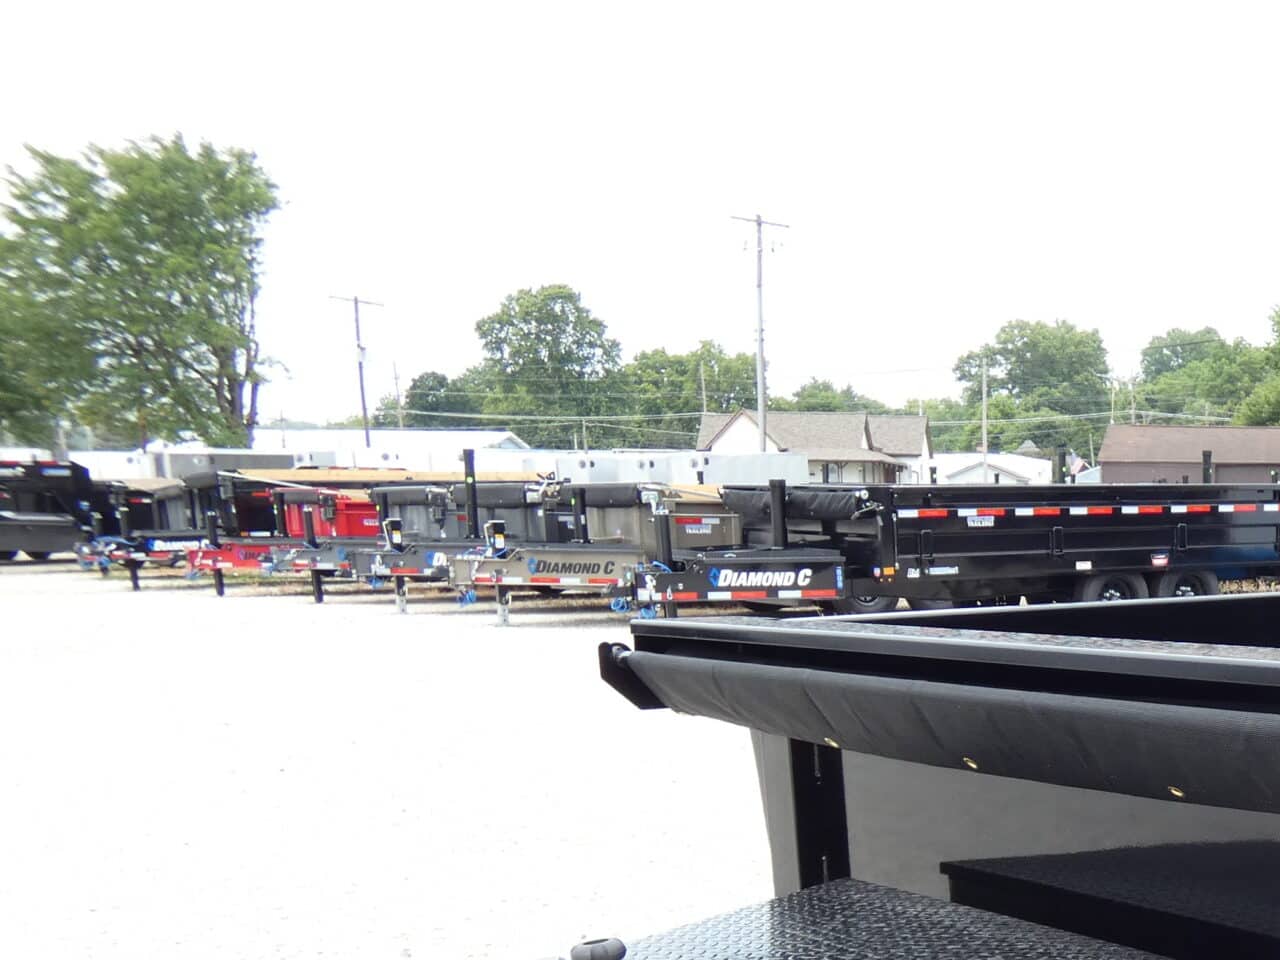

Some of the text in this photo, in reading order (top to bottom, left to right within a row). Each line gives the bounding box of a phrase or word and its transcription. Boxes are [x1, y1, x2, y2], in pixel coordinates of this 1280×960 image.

[536, 560, 615, 575] DIAMOND C
[718, 569, 795, 587] DIAMOND
[797, 568, 813, 587] C
